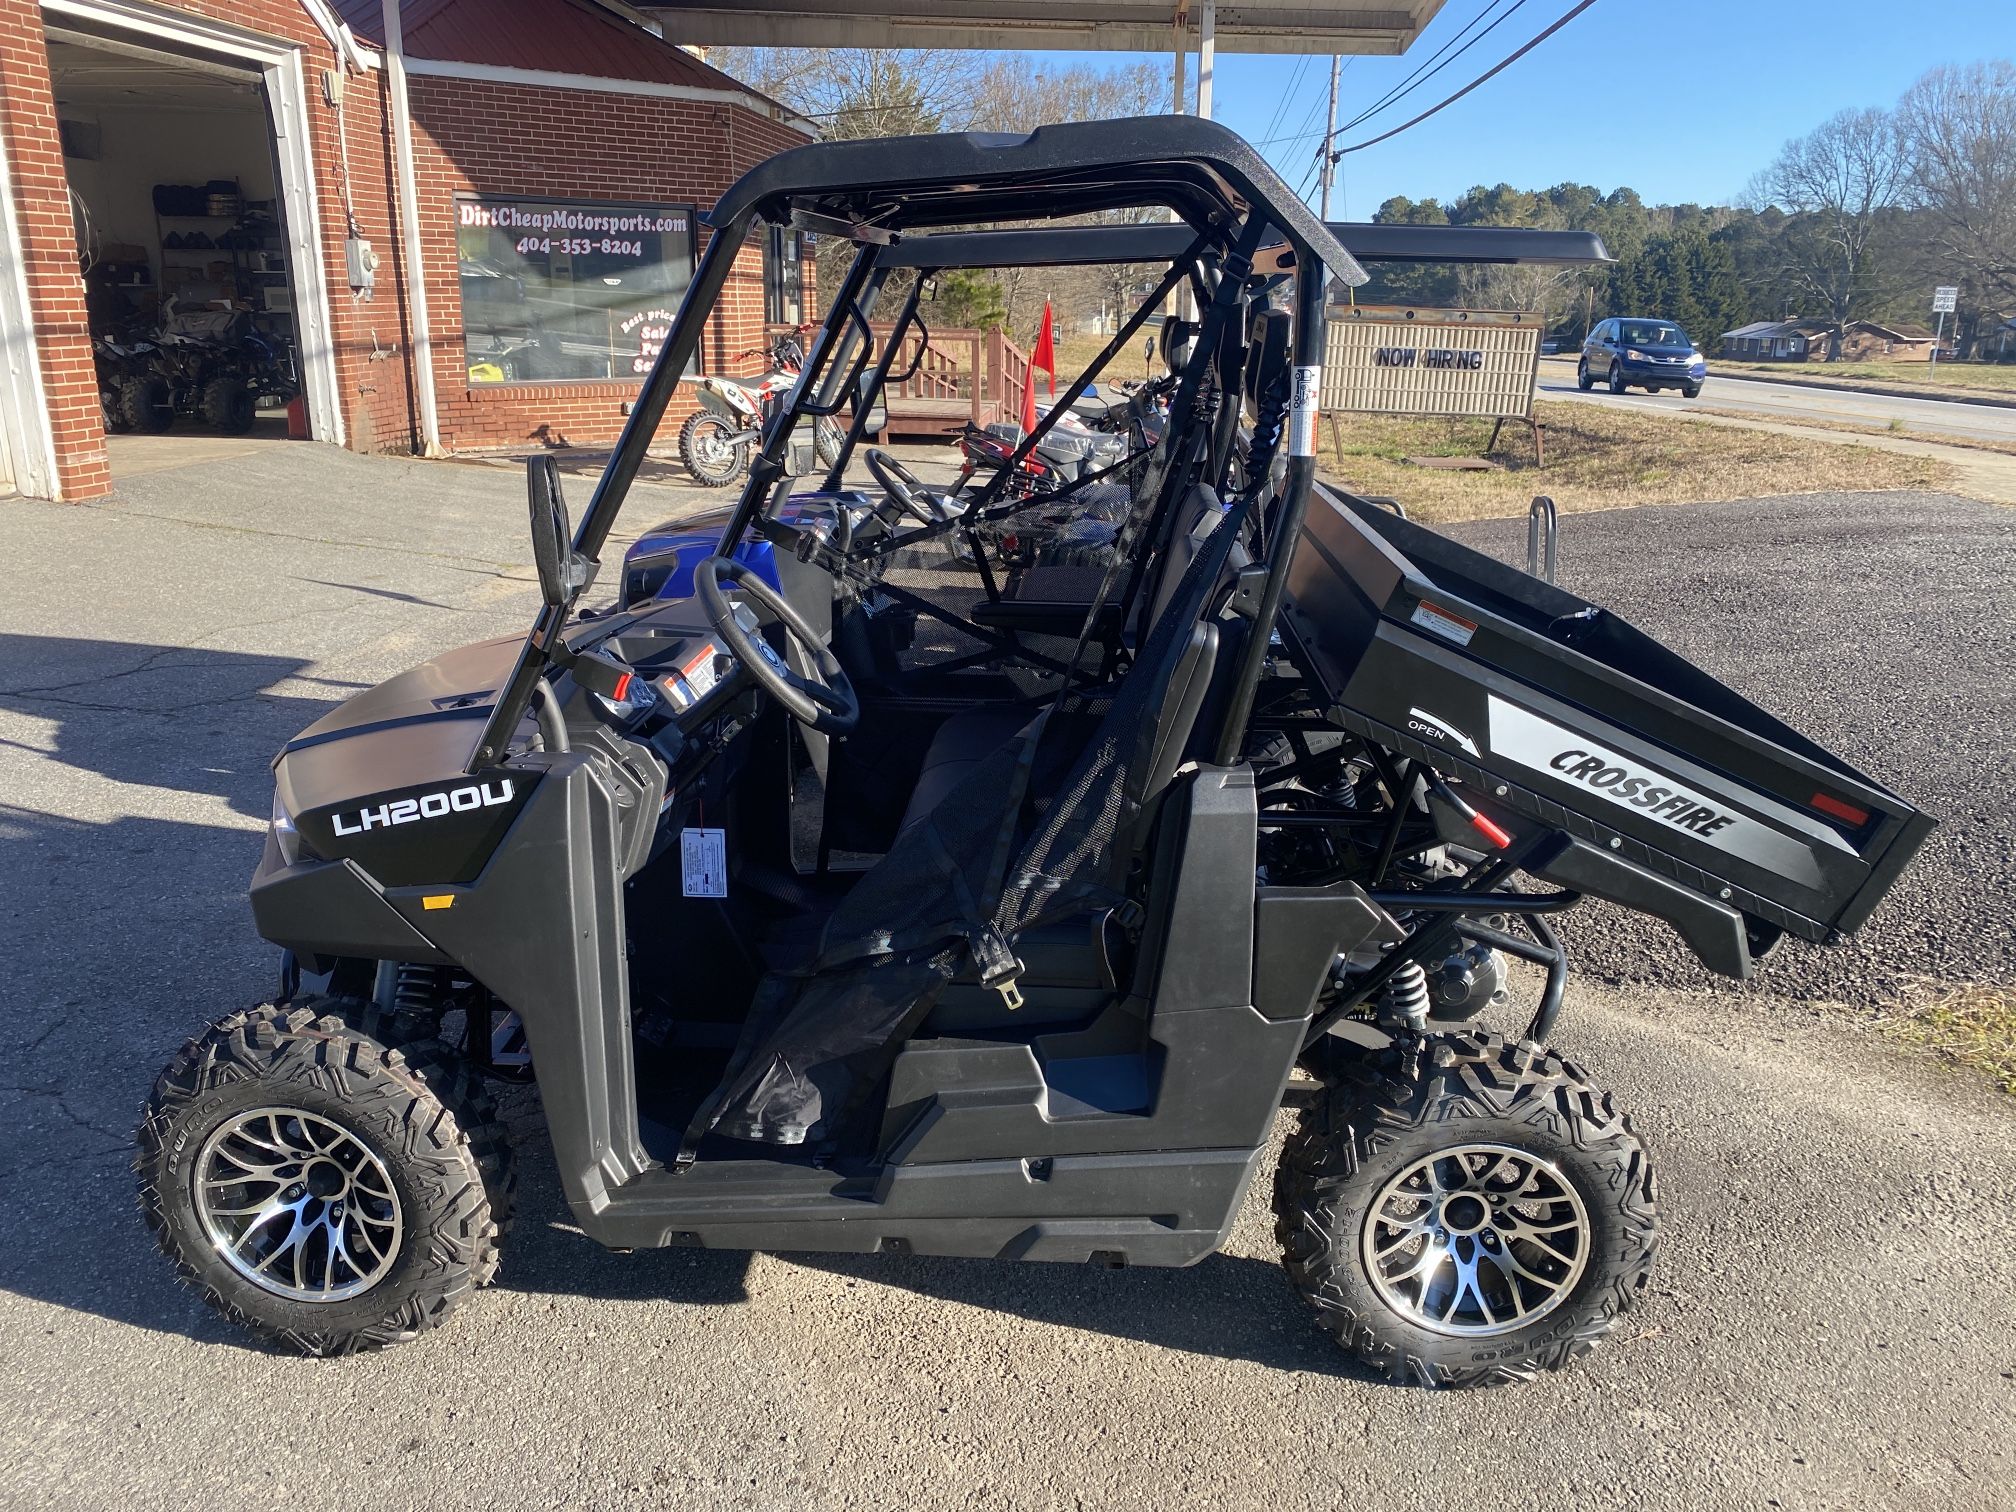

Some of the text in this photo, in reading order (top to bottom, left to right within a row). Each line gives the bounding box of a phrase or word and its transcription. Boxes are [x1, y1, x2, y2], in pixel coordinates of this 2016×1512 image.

[460, 204, 687, 234] DirtCheapMotorsports.com
[516, 237, 642, 257] 404-353-8204
[620, 312, 644, 334] Best
[1377, 347, 1483, 370] NOW HIRNG
[1408, 720, 1445, 740] OPEN
[1549, 750, 1736, 838] CROSSFIRE
[331, 778, 516, 837] LH200U
